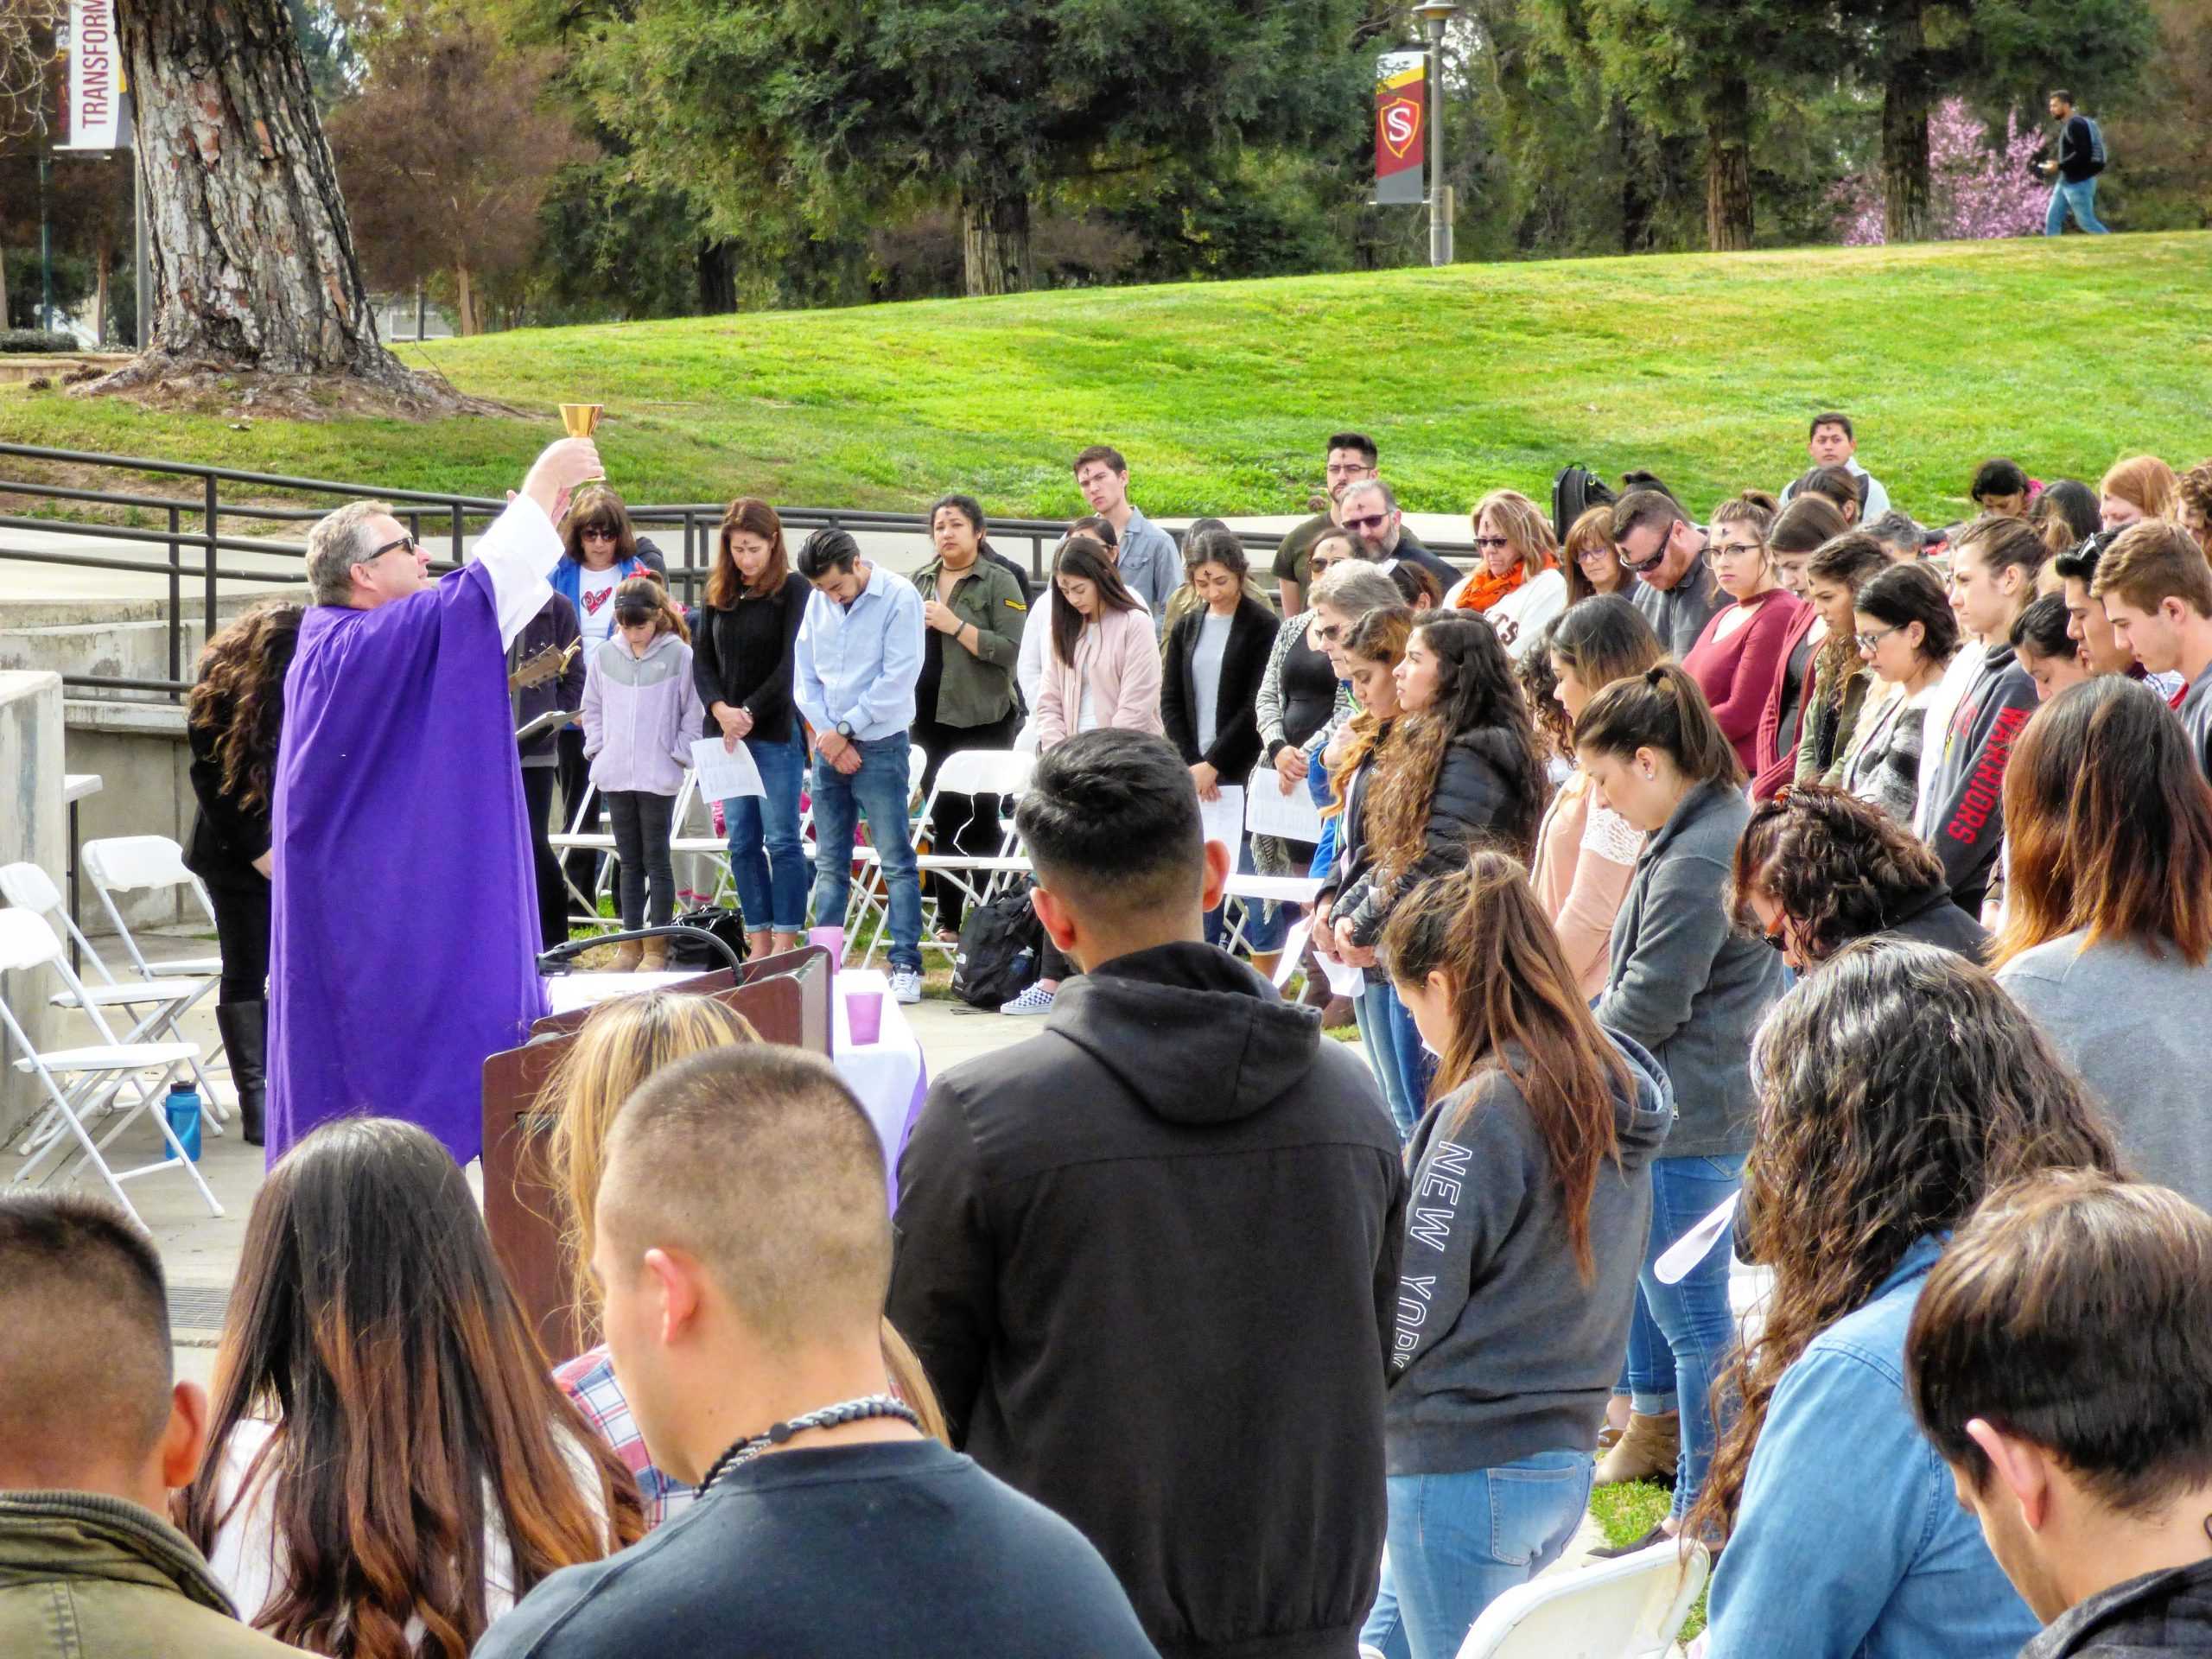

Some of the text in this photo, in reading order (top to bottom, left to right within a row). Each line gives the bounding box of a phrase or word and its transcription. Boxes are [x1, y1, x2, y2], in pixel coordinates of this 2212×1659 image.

[82, 0, 109, 129] TRANSFORM
[1388, 108, 1412, 142] S
[1409, 1140, 1472, 1253] NEW
